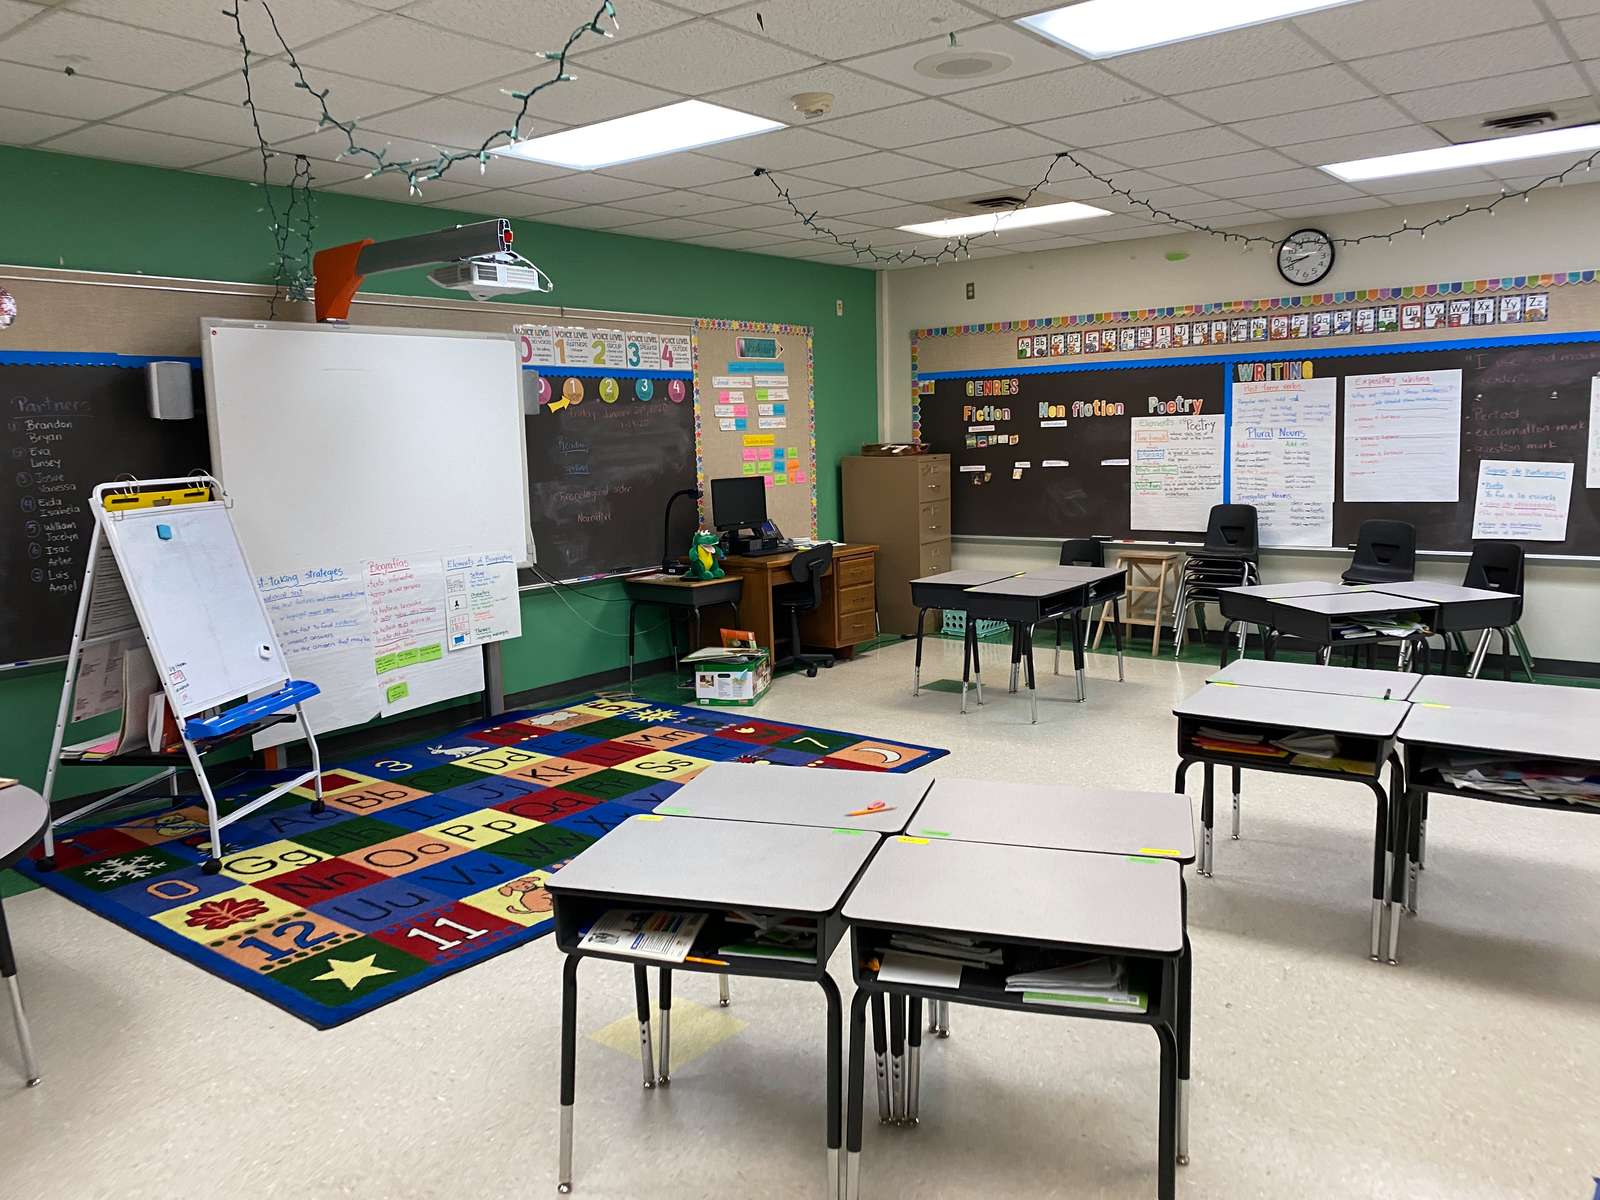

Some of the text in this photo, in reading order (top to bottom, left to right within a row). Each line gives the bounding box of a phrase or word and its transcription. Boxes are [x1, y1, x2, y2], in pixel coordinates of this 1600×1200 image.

[1451, 303, 1470, 312] Ww
[1478, 301, 1491, 311] Xx
[1504, 299, 1518, 310] Yy
[1529, 297, 1543, 307] Zz
[1359, 311, 1371, 320] Ss
[1382, 309, 1393, 318] Tt
[1405, 307, 1418, 316] Uu
[1429, 305, 1441, 314] Vv
[1274, 319, 1286, 327] Oo
[1294, 316, 1304, 325] Pp
[1316, 315, 1329, 325] Qq
[1337, 313, 1348, 322] Rr
[1178, 326, 1186, 336] Jj
[1195, 325, 1205, 334] Kk
[1215, 323, 1223, 331] Ll
[1252, 321, 1263, 329] Nn
[554, 331, 572, 339] VOICE
[591, 332, 624, 341] VOICE LEVEL
[1088, 333, 1097, 342] Ee
[1105, 331, 1114, 339] Ff
[1123, 331, 1132, 340] Gg
[1140, 327, 1150, 337] Hh
[627, 335, 643, 343] VOICE
[661, 337, 675, 345] VOICE
[1035, 338, 1044, 346] Bb
[1053, 336, 1062, 344] Cc
[1069, 335, 1078, 343] Dd
[554, 339, 566, 363] 1
[591, 340, 606, 365] 2
[628, 342, 640, 367] 3
[661, 344, 673, 368] 4
[1237, 361, 1313, 381] WRITING
[606, 379, 612, 393] 2
[642, 379, 648, 391] 3
[673, 380, 680, 393] 4
[966, 379, 1019, 396] GENRES
[1038, 401, 1066, 418] Non
[1148, 396, 1204, 416] Poetry
[963, 405, 1010, 422] Fiction
[24, 419, 72, 431] Brandon
[1186, 418, 1216, 433] Poetry
[26, 432, 62, 444] Bryan
[1246, 427, 1306, 438] Plural Nouns
[304, 567, 344, 581] strategies
[624, 730, 695, 748] Mm
[374, 760, 413, 772] 3
[469, 751, 537, 770] Dd
[635, 759, 693, 774] Ss
[518, 765, 589, 782] Kk
[335, 790, 408, 809] Bb
[509, 796, 603, 817] Qq
[267, 809, 344, 834] Aa
[439, 819, 517, 842] Pp
[498, 832, 583, 860] Ww
[363, 843, 450, 868] Oo
[224, 850, 324, 875] Gg
[421, 863, 504, 887] Vv
[276, 870, 367, 899] Nn
[333, 892, 429, 922] Uu
[407, 917, 489, 951] 11
[239, 921, 339, 962] 12
